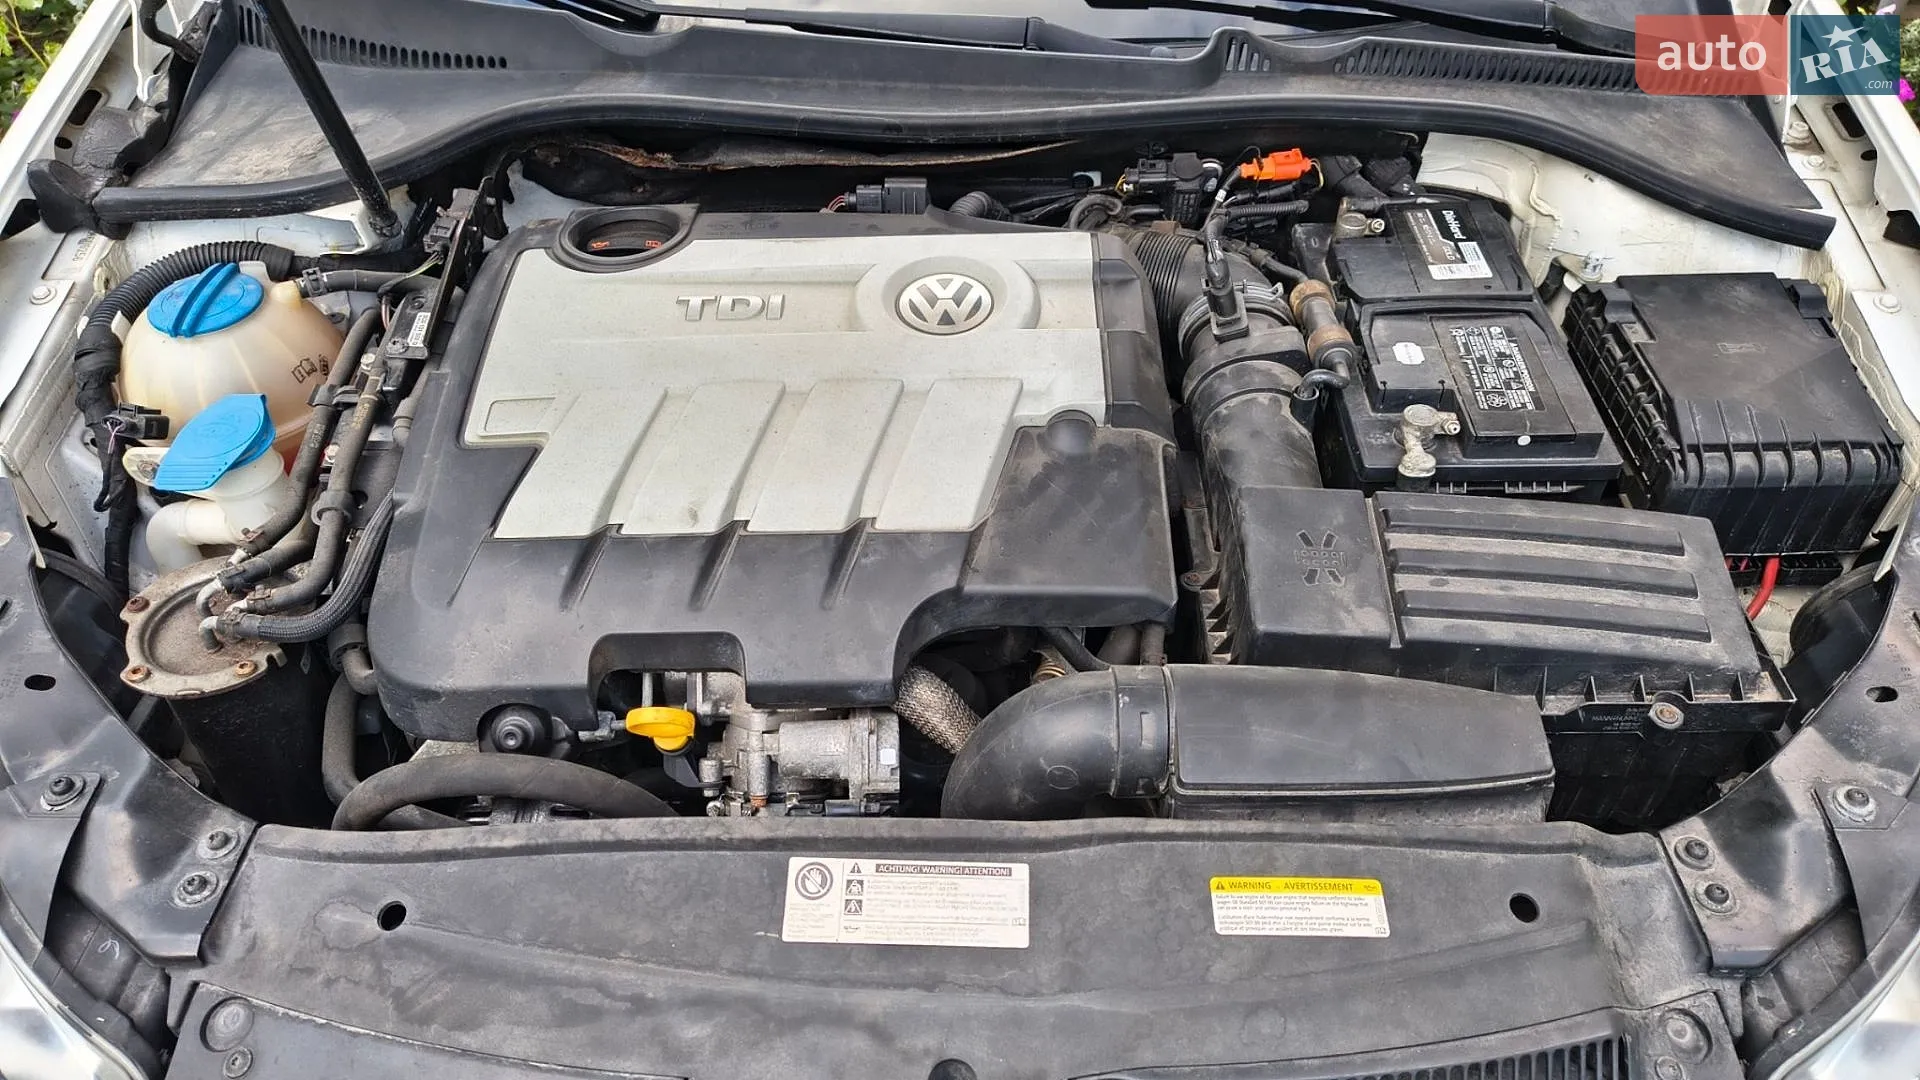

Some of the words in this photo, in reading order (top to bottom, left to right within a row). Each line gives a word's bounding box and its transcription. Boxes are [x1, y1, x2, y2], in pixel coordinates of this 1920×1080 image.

[676, 294, 785, 321] TDI
[878, 865, 921, 875] ACHTUNG!
[922, 866, 963, 876] WARNING!
[964, 867, 1011, 877] ATTENTION!
[1228, 881, 1272, 890] WARNING
[1284, 882, 1353, 891] AVERTISSEMENT
